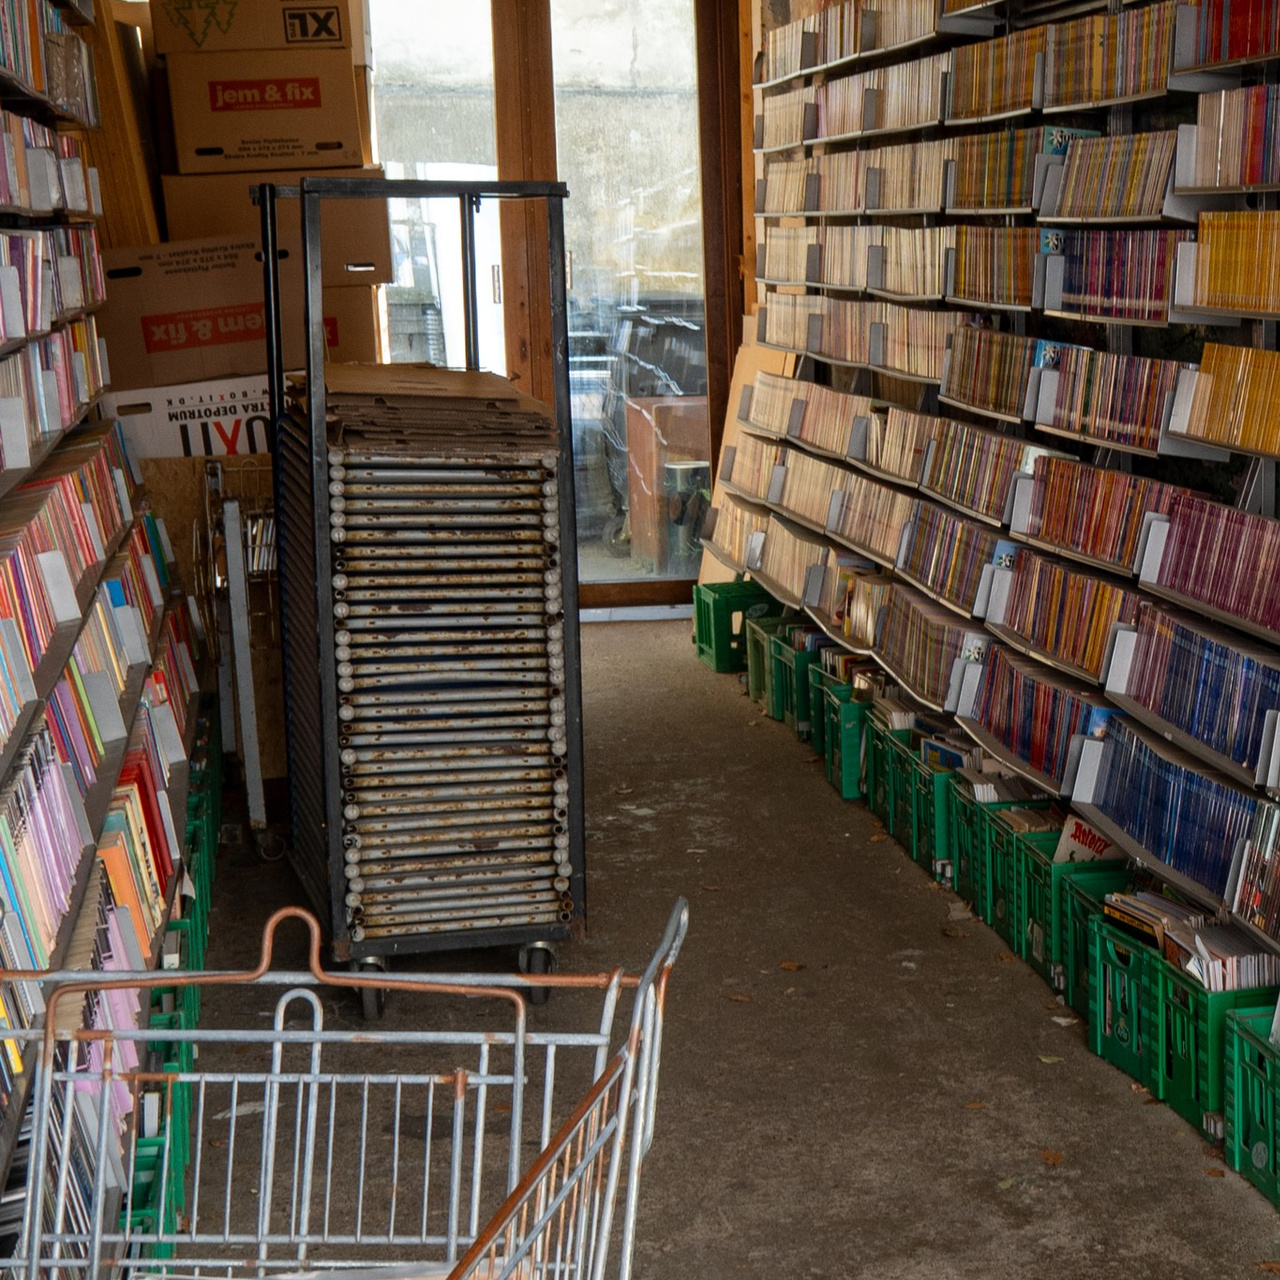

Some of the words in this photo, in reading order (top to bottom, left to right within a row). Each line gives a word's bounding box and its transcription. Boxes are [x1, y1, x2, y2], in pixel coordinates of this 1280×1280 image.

[288, 12, 336, 38] XL
[216, 85, 260, 107] jem
[264, 84, 282, 101] &
[285, 83, 315, 100] fix
[150, 322, 187, 344] fix
[191, 319, 212, 341] &
[168, 404, 237, 422] DEPOTRUM
[1070, 821, 1112, 857] Asterix
